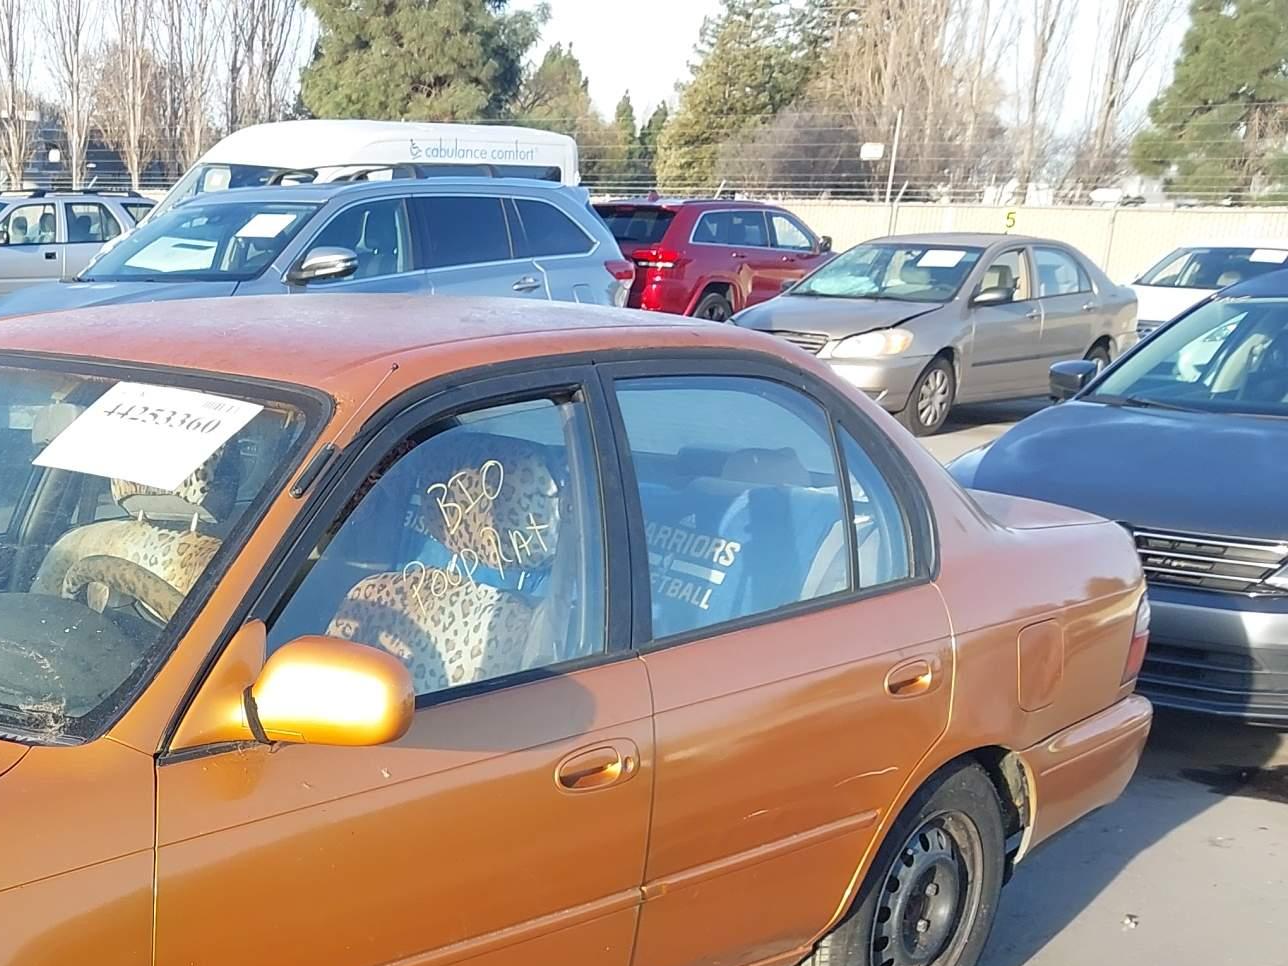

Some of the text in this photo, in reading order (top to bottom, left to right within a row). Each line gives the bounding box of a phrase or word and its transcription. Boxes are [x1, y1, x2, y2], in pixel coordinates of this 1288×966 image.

[425, 138, 534, 160] cabulance comfort
[1006, 211, 1016, 228] 5
[104, 404, 222, 433] 44253360
[427, 460, 504, 535] BIO
[403, 548, 482, 616] POOP
